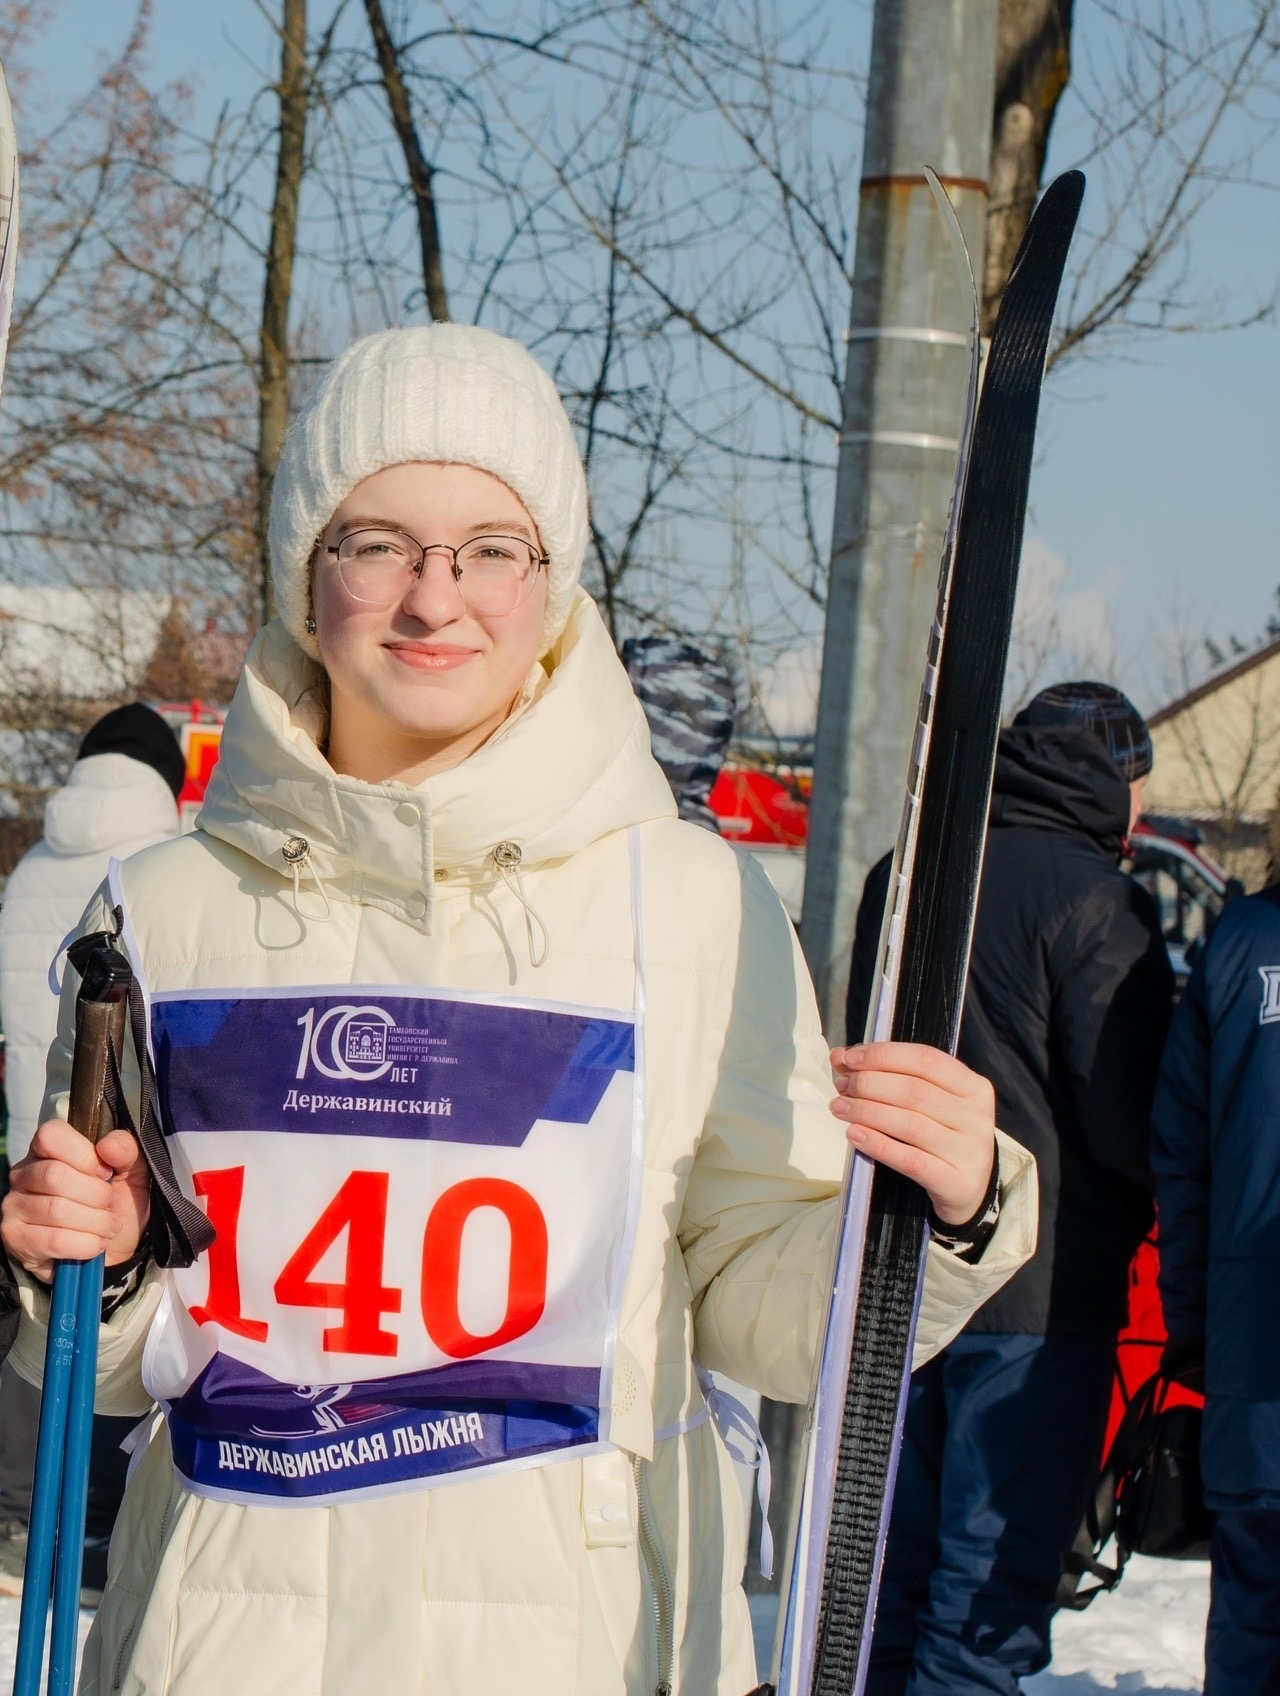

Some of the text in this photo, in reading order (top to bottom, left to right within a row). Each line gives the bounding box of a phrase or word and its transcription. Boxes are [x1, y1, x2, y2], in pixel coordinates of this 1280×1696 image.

[389, 1027, 429, 1035] ТАМБОВСКИЙ
[388, 1035, 447, 1046] ГОСУДАРСТВЕННЫЙ
[387, 1045, 429, 1054] УНИВЕРСИТЕТ
[420, 1055, 458, 1065] ДЕРЖАВИНА
[390, 1067, 418, 1083] ЛЕТ
[282, 1089, 453, 1116] Державинский
[187, 1165, 549, 1359] 140
[218, 1411, 485, 1478] ДЕРЖАВИНСКАЯ ЛЫЖНЯ
